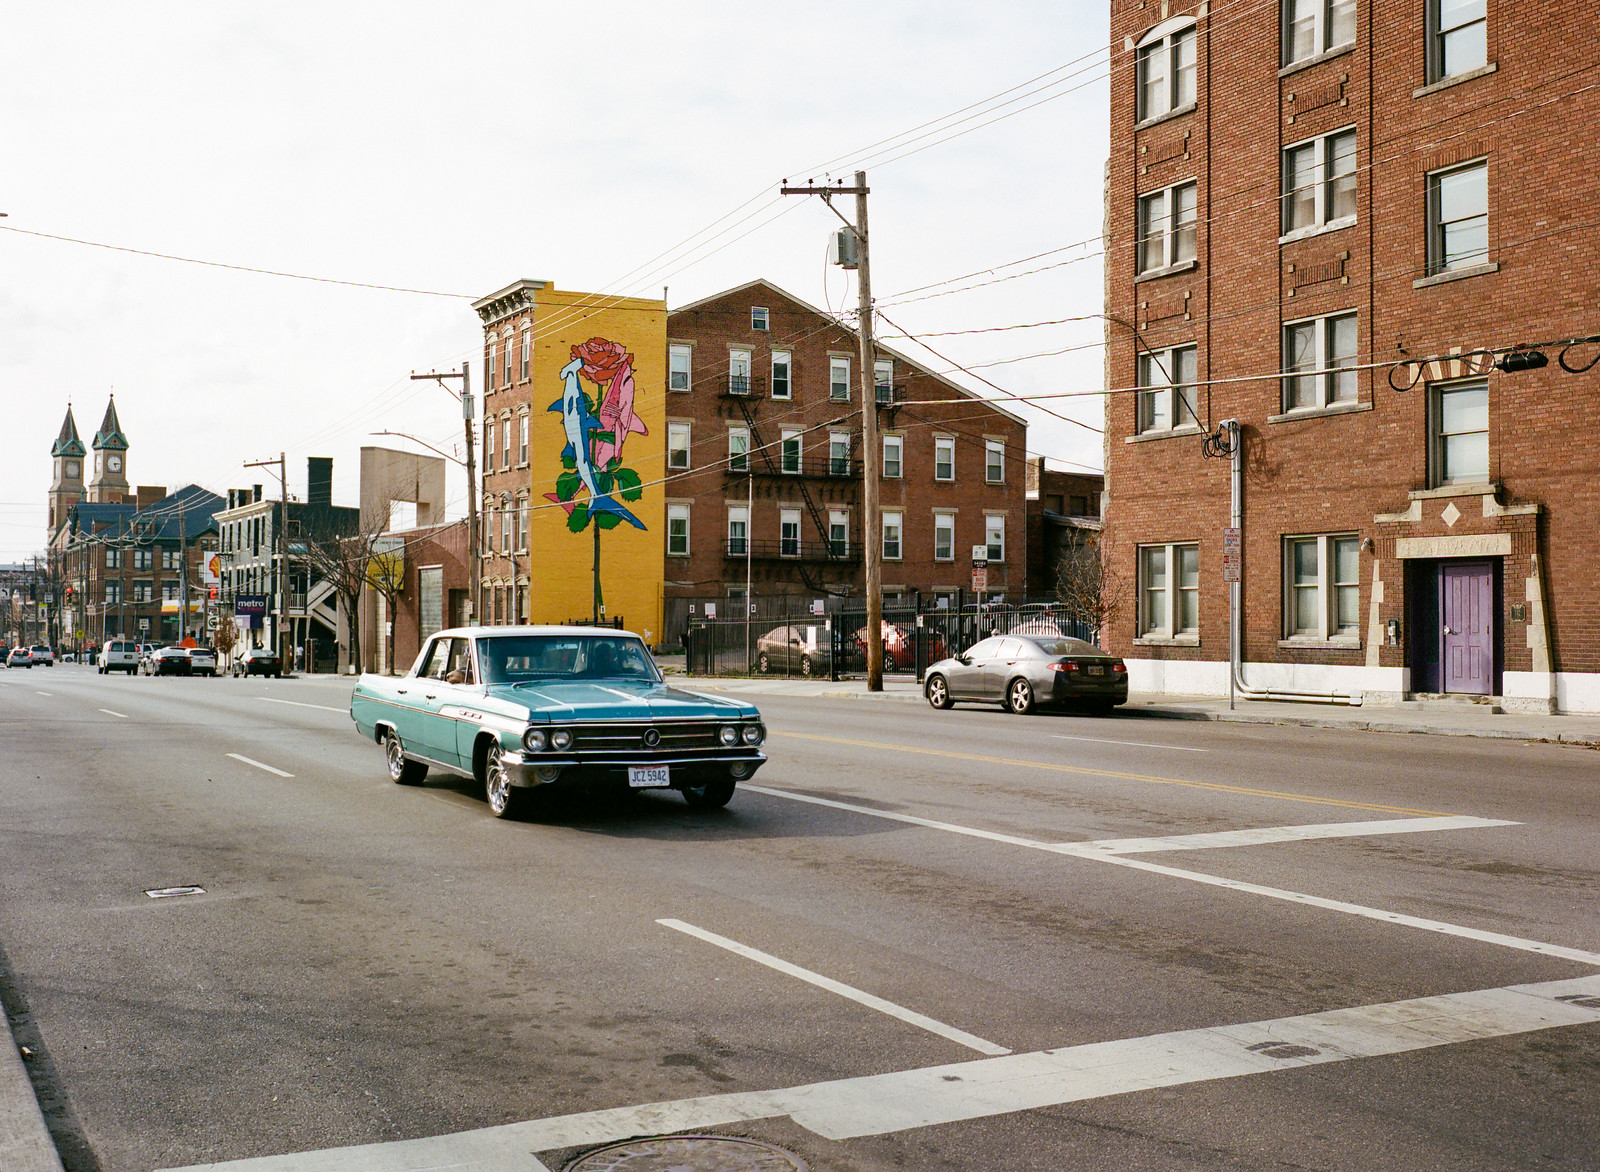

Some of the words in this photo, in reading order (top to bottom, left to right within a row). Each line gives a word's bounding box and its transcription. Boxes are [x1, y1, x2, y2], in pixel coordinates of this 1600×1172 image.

[238, 600, 264, 608] metro
[632, 770, 646, 782] JCZ
[647, 770, 666, 782] 5942
